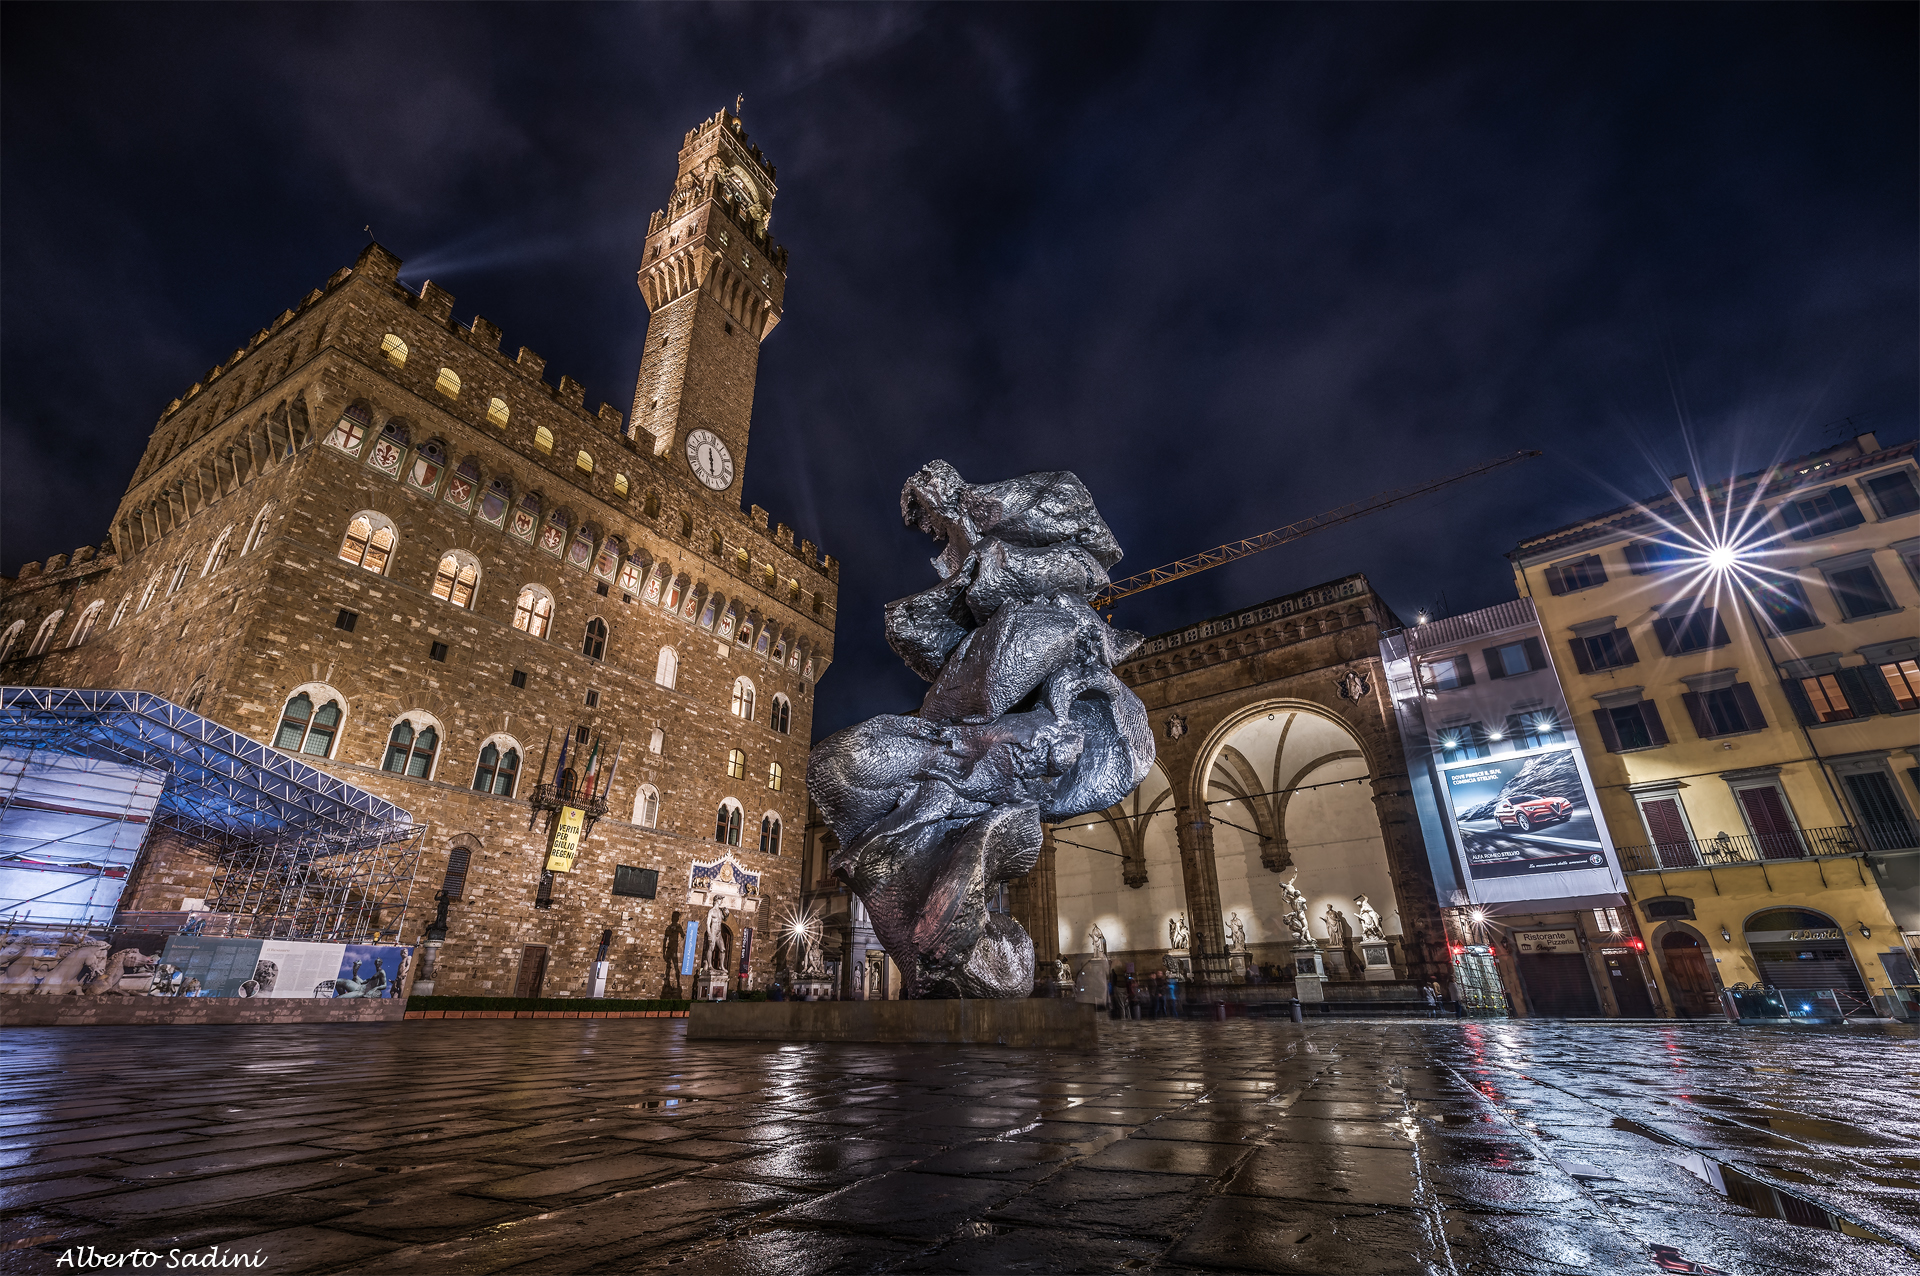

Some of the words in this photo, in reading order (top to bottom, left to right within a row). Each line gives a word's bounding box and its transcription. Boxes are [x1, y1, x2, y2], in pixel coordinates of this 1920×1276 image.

[560, 824, 580, 834] VERITÀ
[556, 832, 568, 840] PER
[554, 840, 575, 850] GIULIO
[551, 849, 574, 859] REGENI
[1524, 932, 1565, 941] Ristorante
[1800, 929, 1840, 940] David
